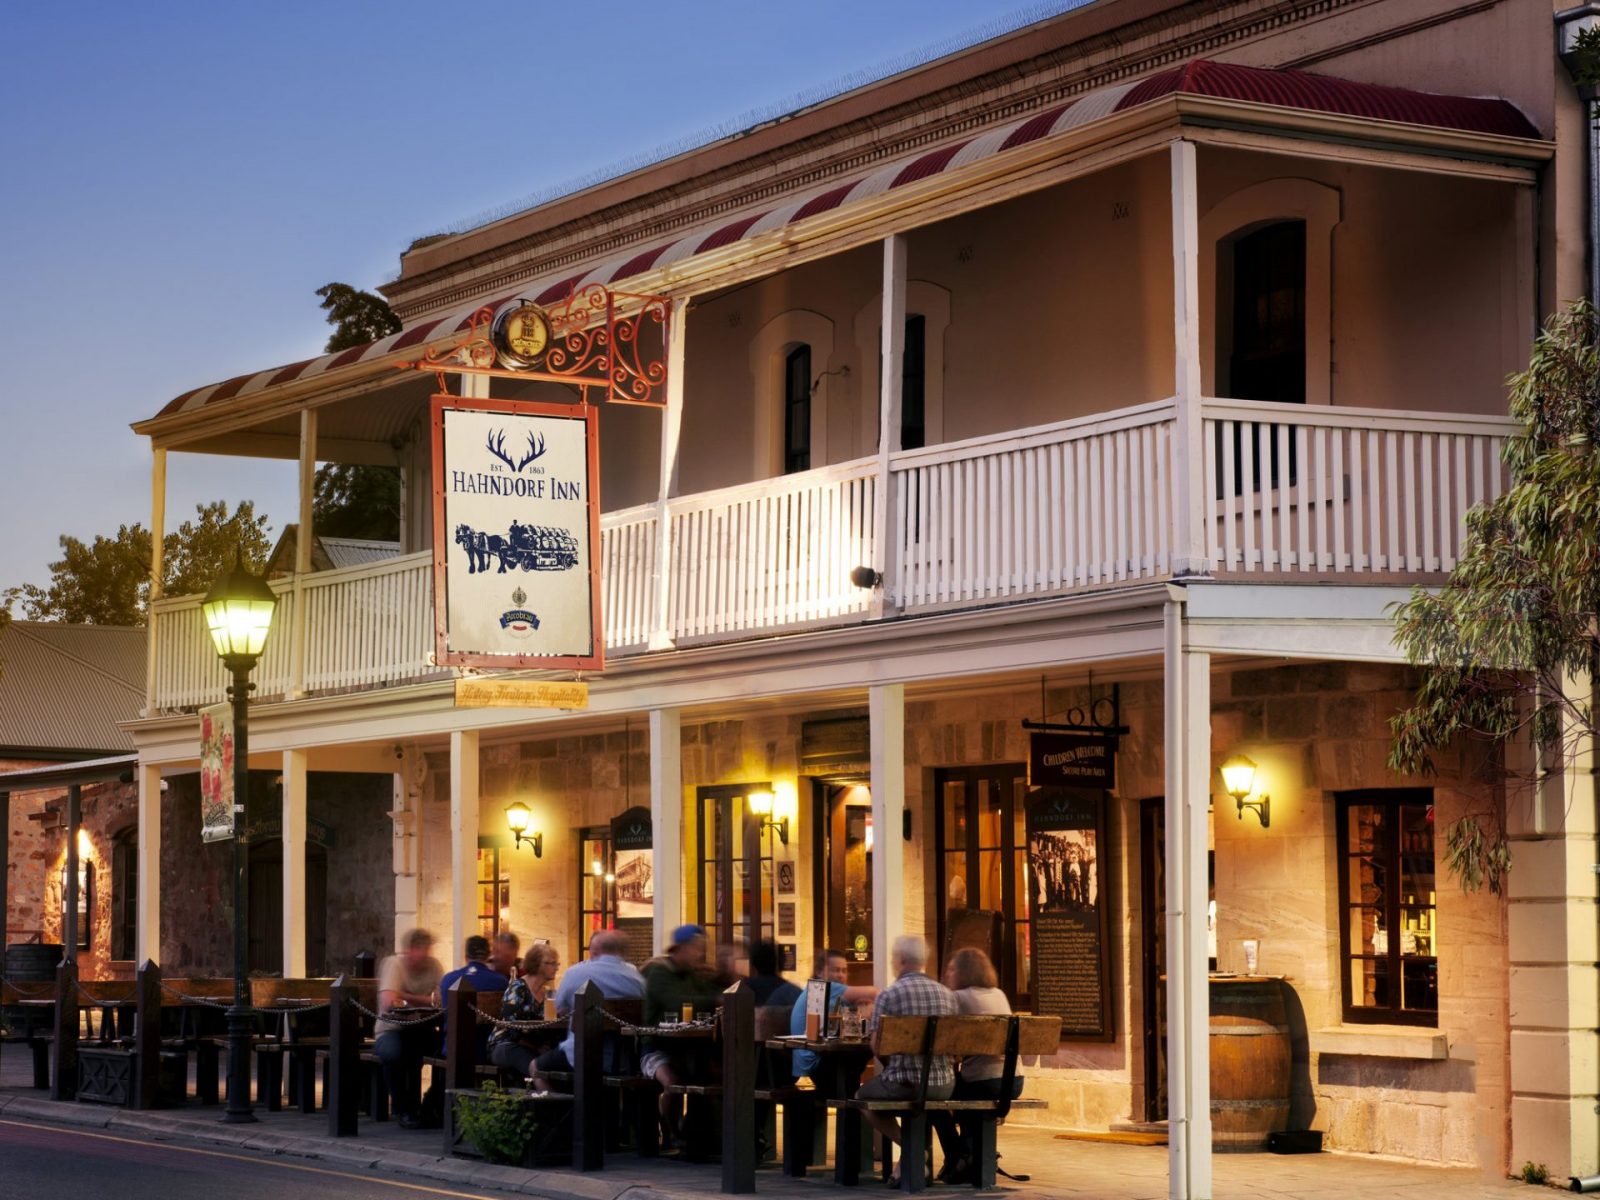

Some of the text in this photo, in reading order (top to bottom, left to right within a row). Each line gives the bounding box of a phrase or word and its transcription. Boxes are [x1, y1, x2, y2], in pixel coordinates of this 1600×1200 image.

[529, 466, 545, 475] 1863
[452, 470, 580, 501] HAHNDORF INN
